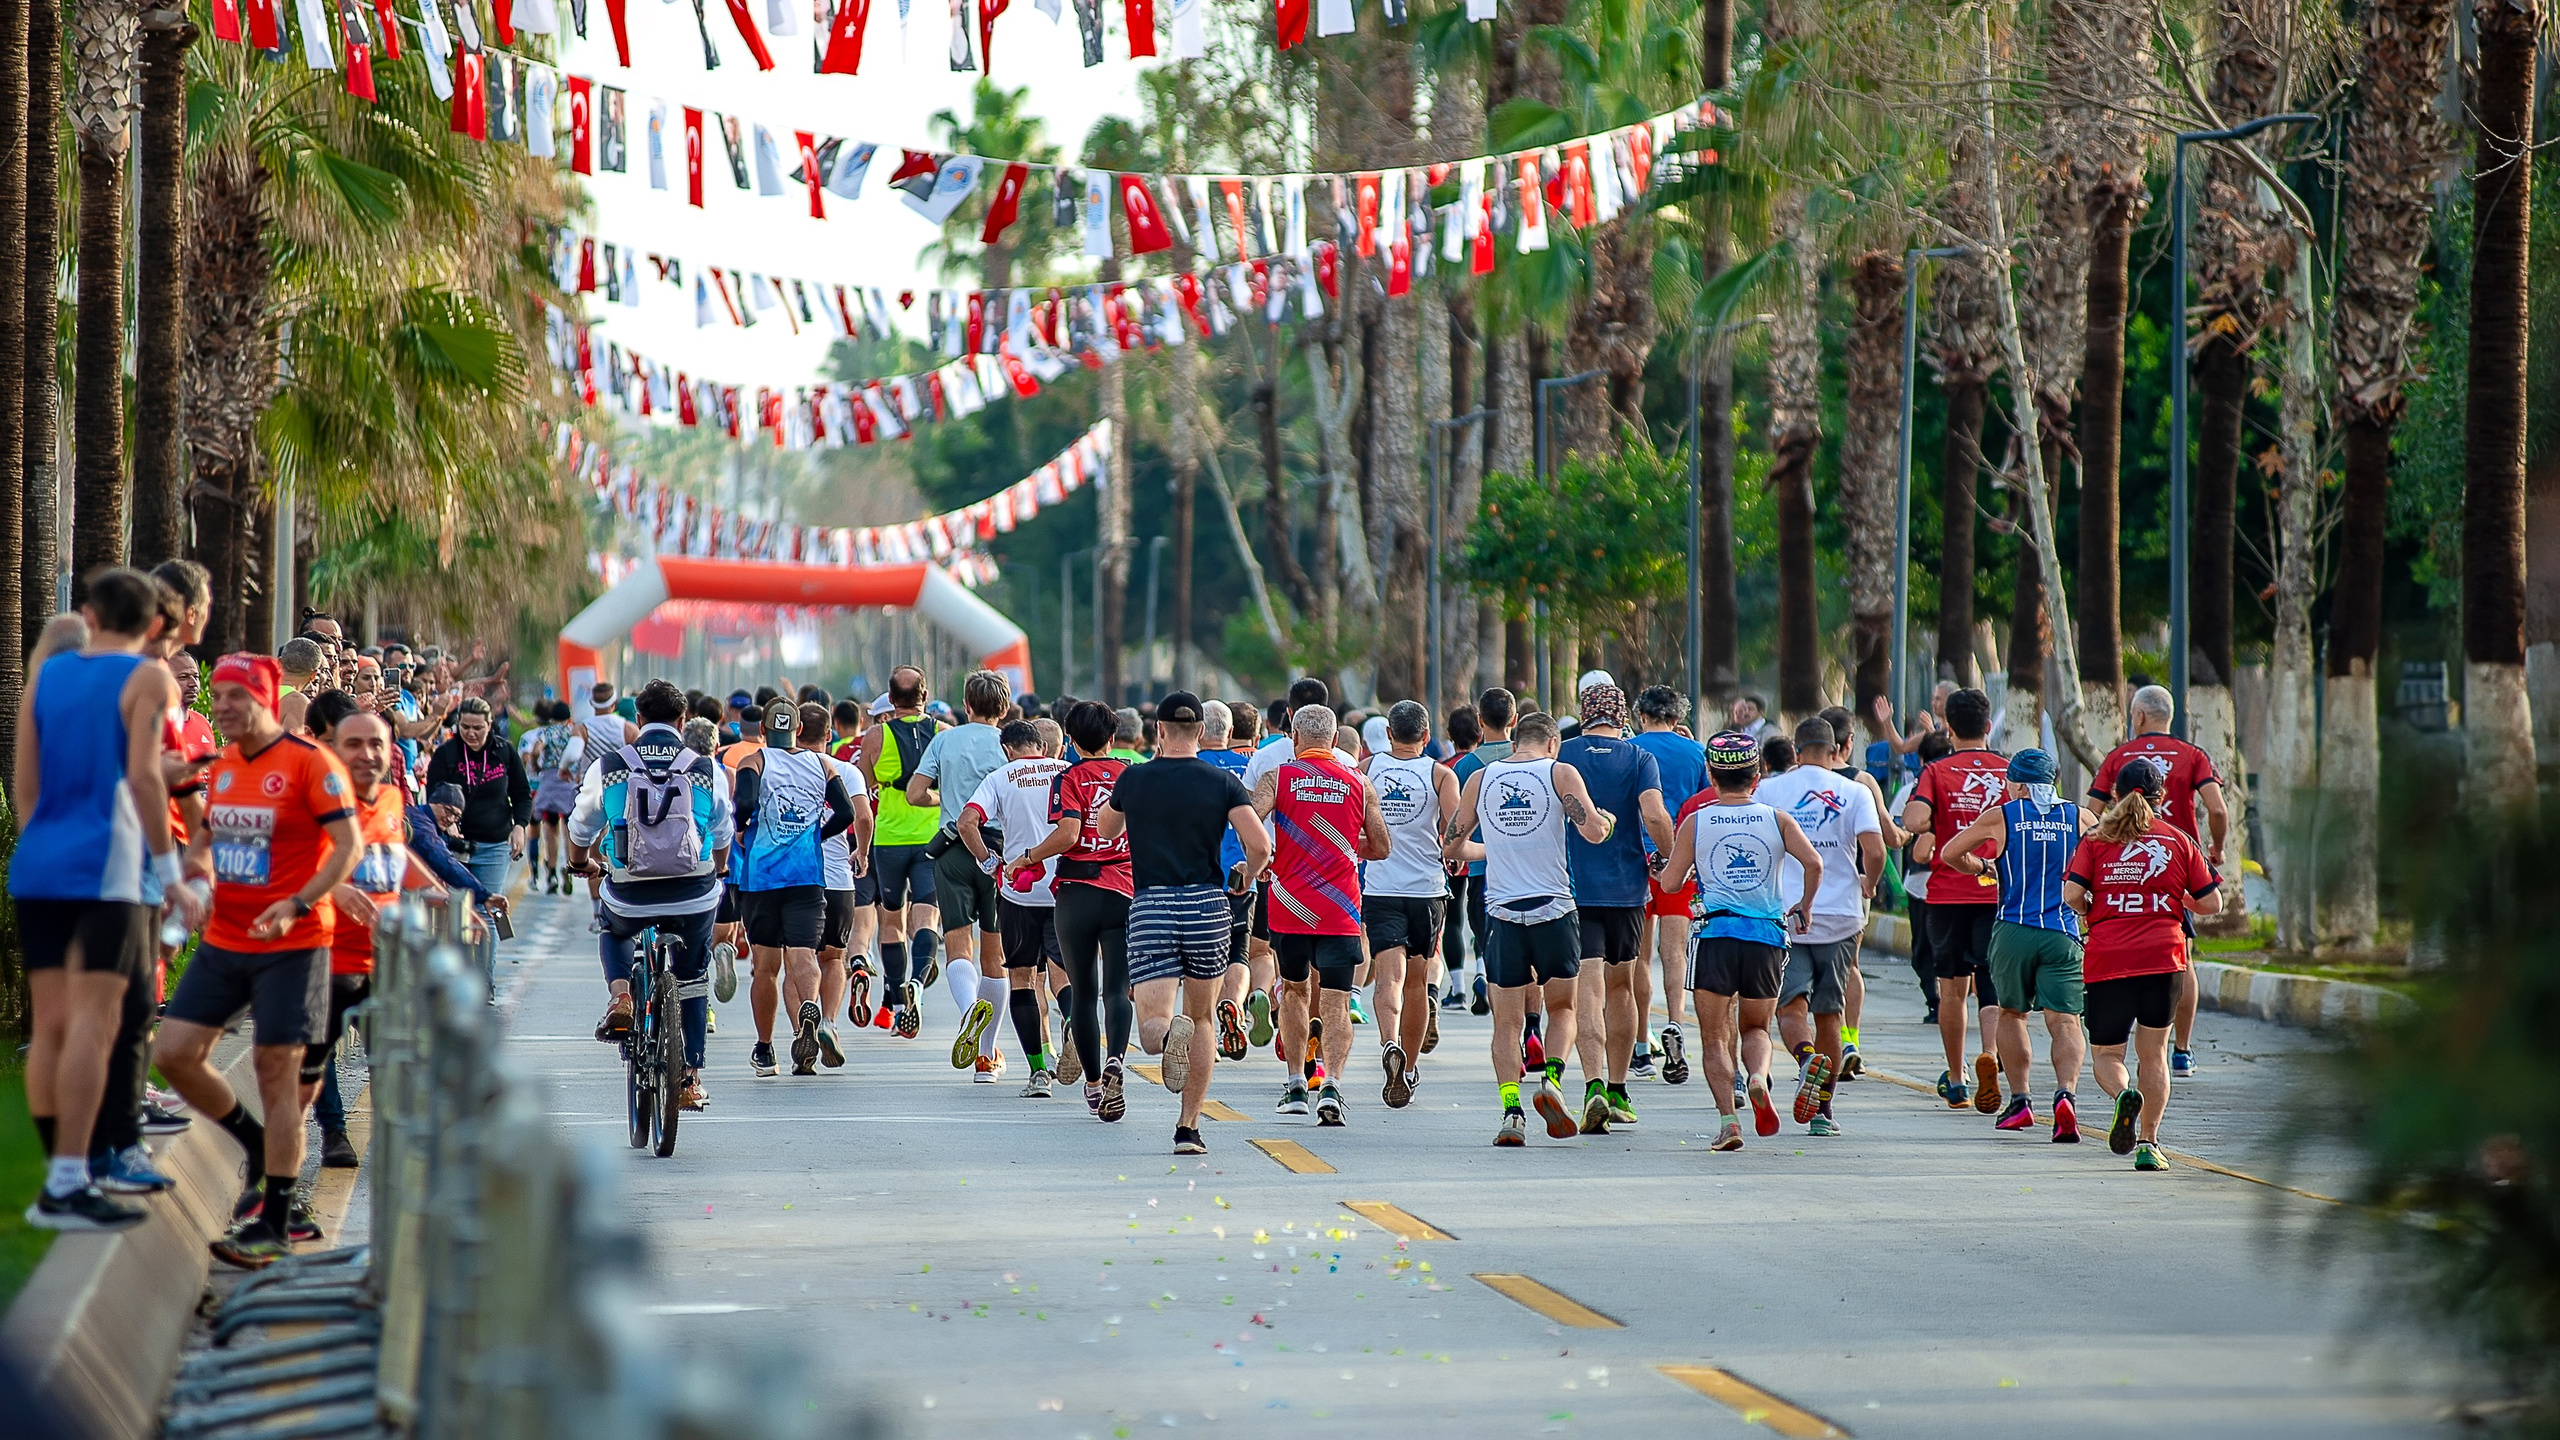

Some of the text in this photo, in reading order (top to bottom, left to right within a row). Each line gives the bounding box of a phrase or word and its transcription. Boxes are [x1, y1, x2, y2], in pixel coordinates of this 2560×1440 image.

[637, 745, 679, 756] BULAN
[1710, 814, 1763, 825] Shokirjon
[2015, 821, 2073, 832] EGE MARATON
[2033, 830, 2057, 841] İZMİR
[218, 848, 258, 876] 2102
[2113, 867, 2143, 875] MERSİN
[2107, 893, 2172, 913] 42 K
